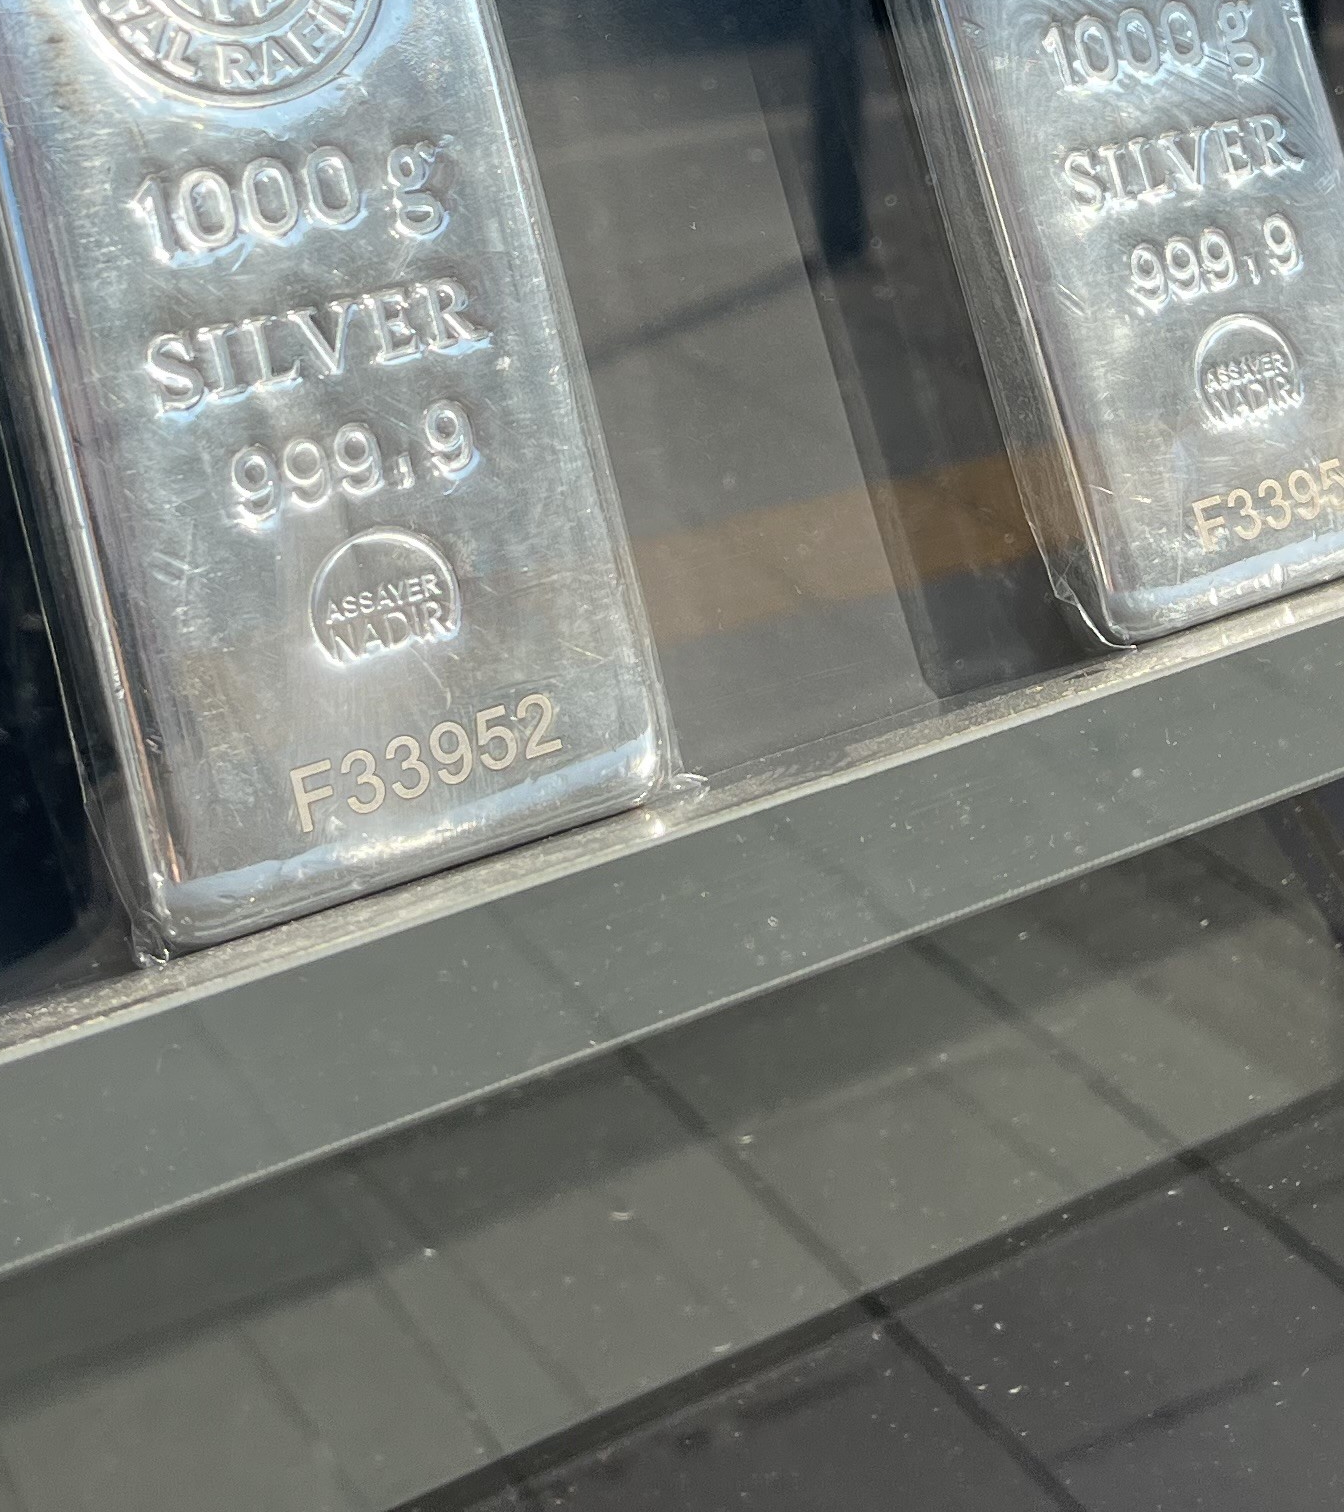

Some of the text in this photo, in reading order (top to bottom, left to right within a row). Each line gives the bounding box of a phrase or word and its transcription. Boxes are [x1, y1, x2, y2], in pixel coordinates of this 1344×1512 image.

[1042, 0, 1206, 91] 1000
[128, 135, 453, 268] 1000 g
[1062, 113, 1305, 214] SILVER
[146, 278, 492, 419] SILVER
[326, 571, 443, 624] ASSAYER
[289, 693, 562, 834] F33952
